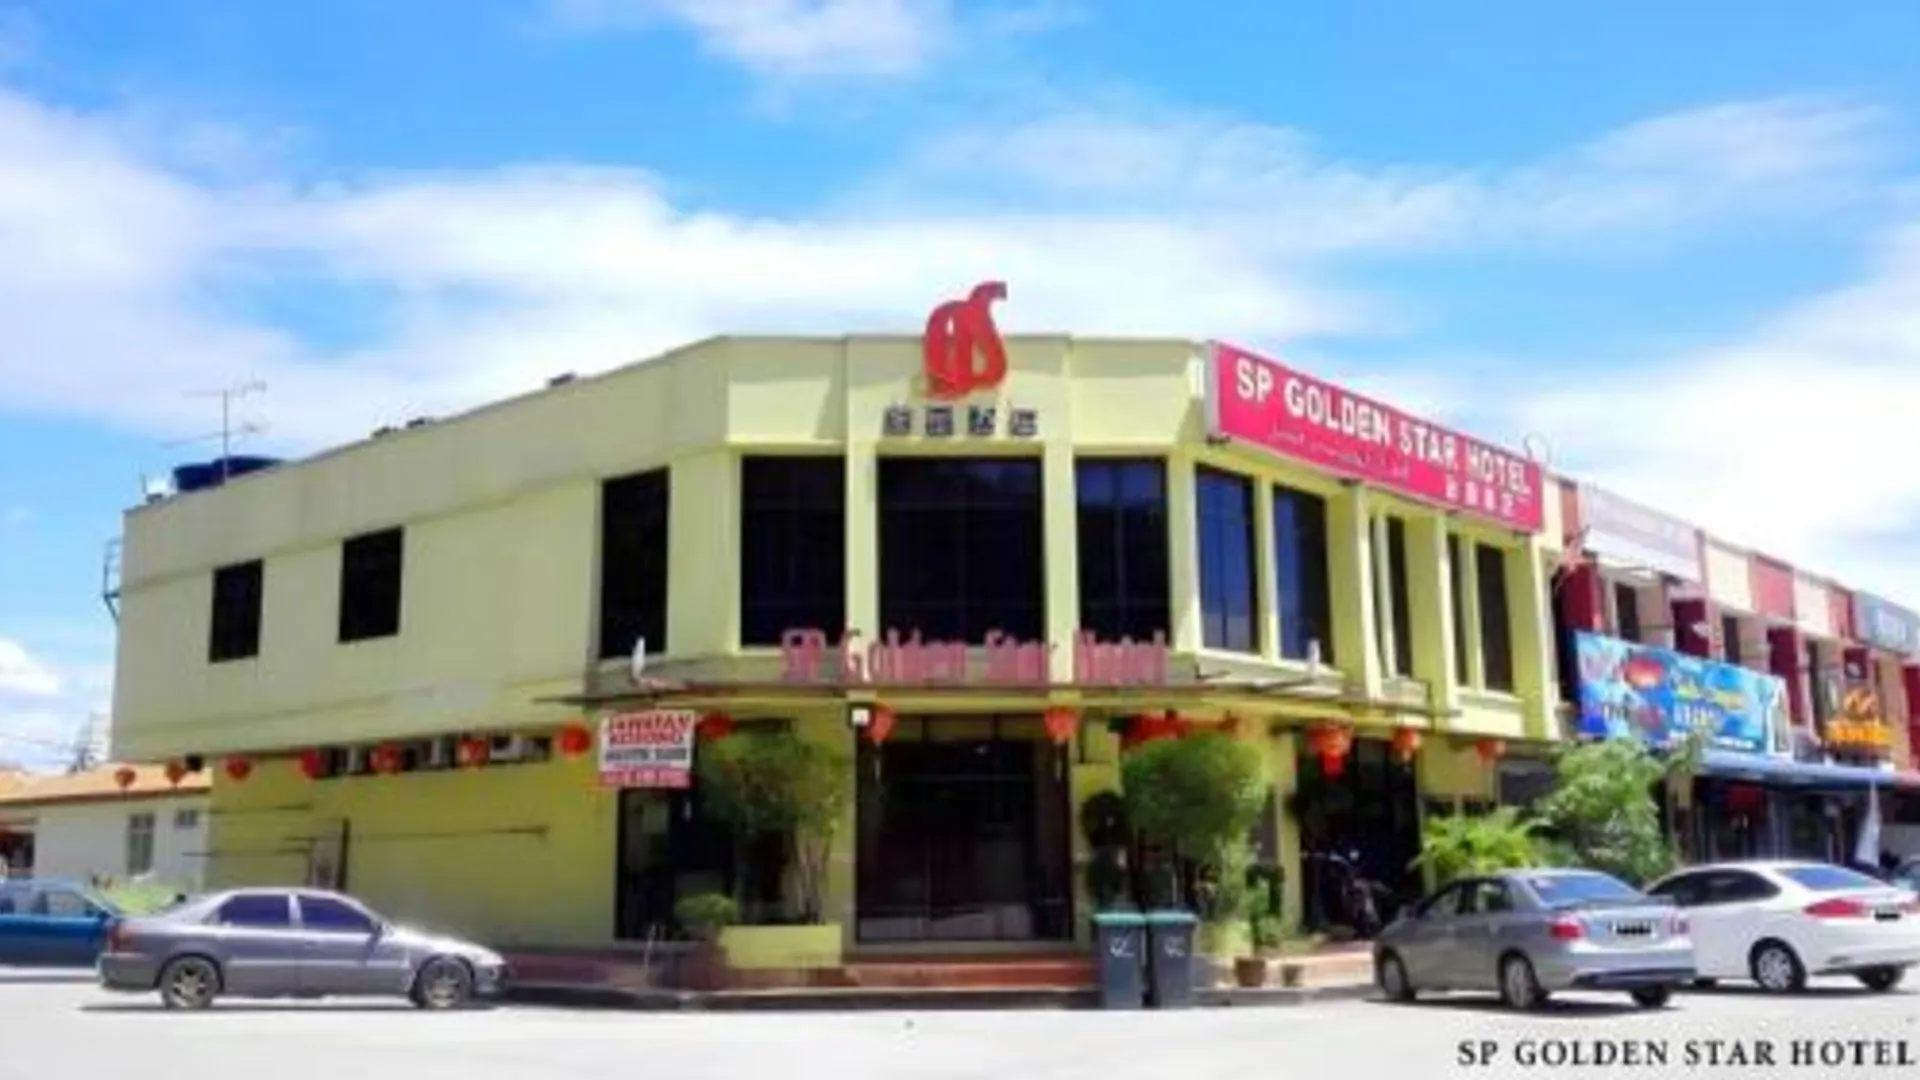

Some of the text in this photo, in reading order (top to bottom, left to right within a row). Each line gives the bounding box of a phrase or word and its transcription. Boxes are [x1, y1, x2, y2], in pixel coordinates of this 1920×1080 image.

[1236, 358, 1273, 403] SP
[1284, 378, 1390, 445] GOLDEN
[1399, 420, 1457, 470] STAR
[1466, 438, 1532, 496] HOTEL
[782, 628, 1168, 684] SP Golden Star Hotel
